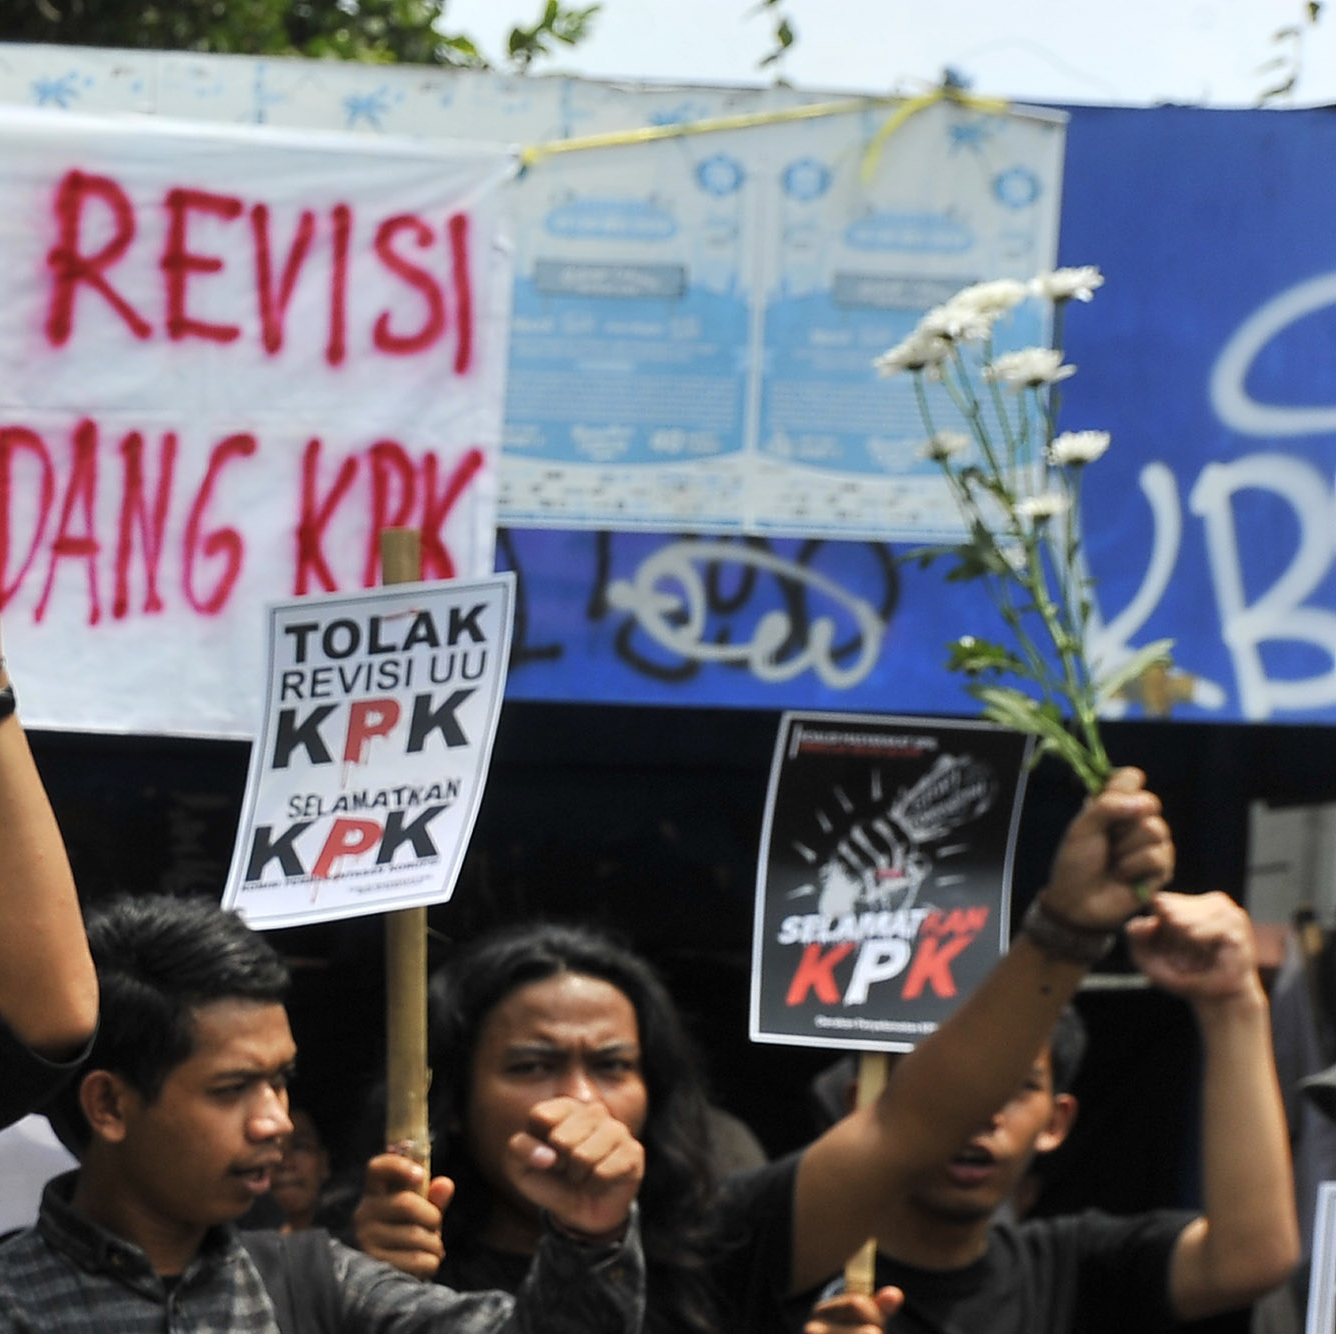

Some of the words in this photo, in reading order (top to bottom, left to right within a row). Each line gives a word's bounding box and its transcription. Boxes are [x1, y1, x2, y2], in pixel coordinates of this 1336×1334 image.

[43, 167, 476, 376] REVISI
[293, 436, 485, 597] KPK
[284, 603, 488, 664] TOLAK
[280, 657, 414, 702] REVISI
[430, 650, 487, 685] UU
[271, 687, 477, 770] KPK
[287, 776, 463, 819] SELAMATKAN
[245, 804, 450, 883] KPK
[785, 932, 979, 1007] KPK
